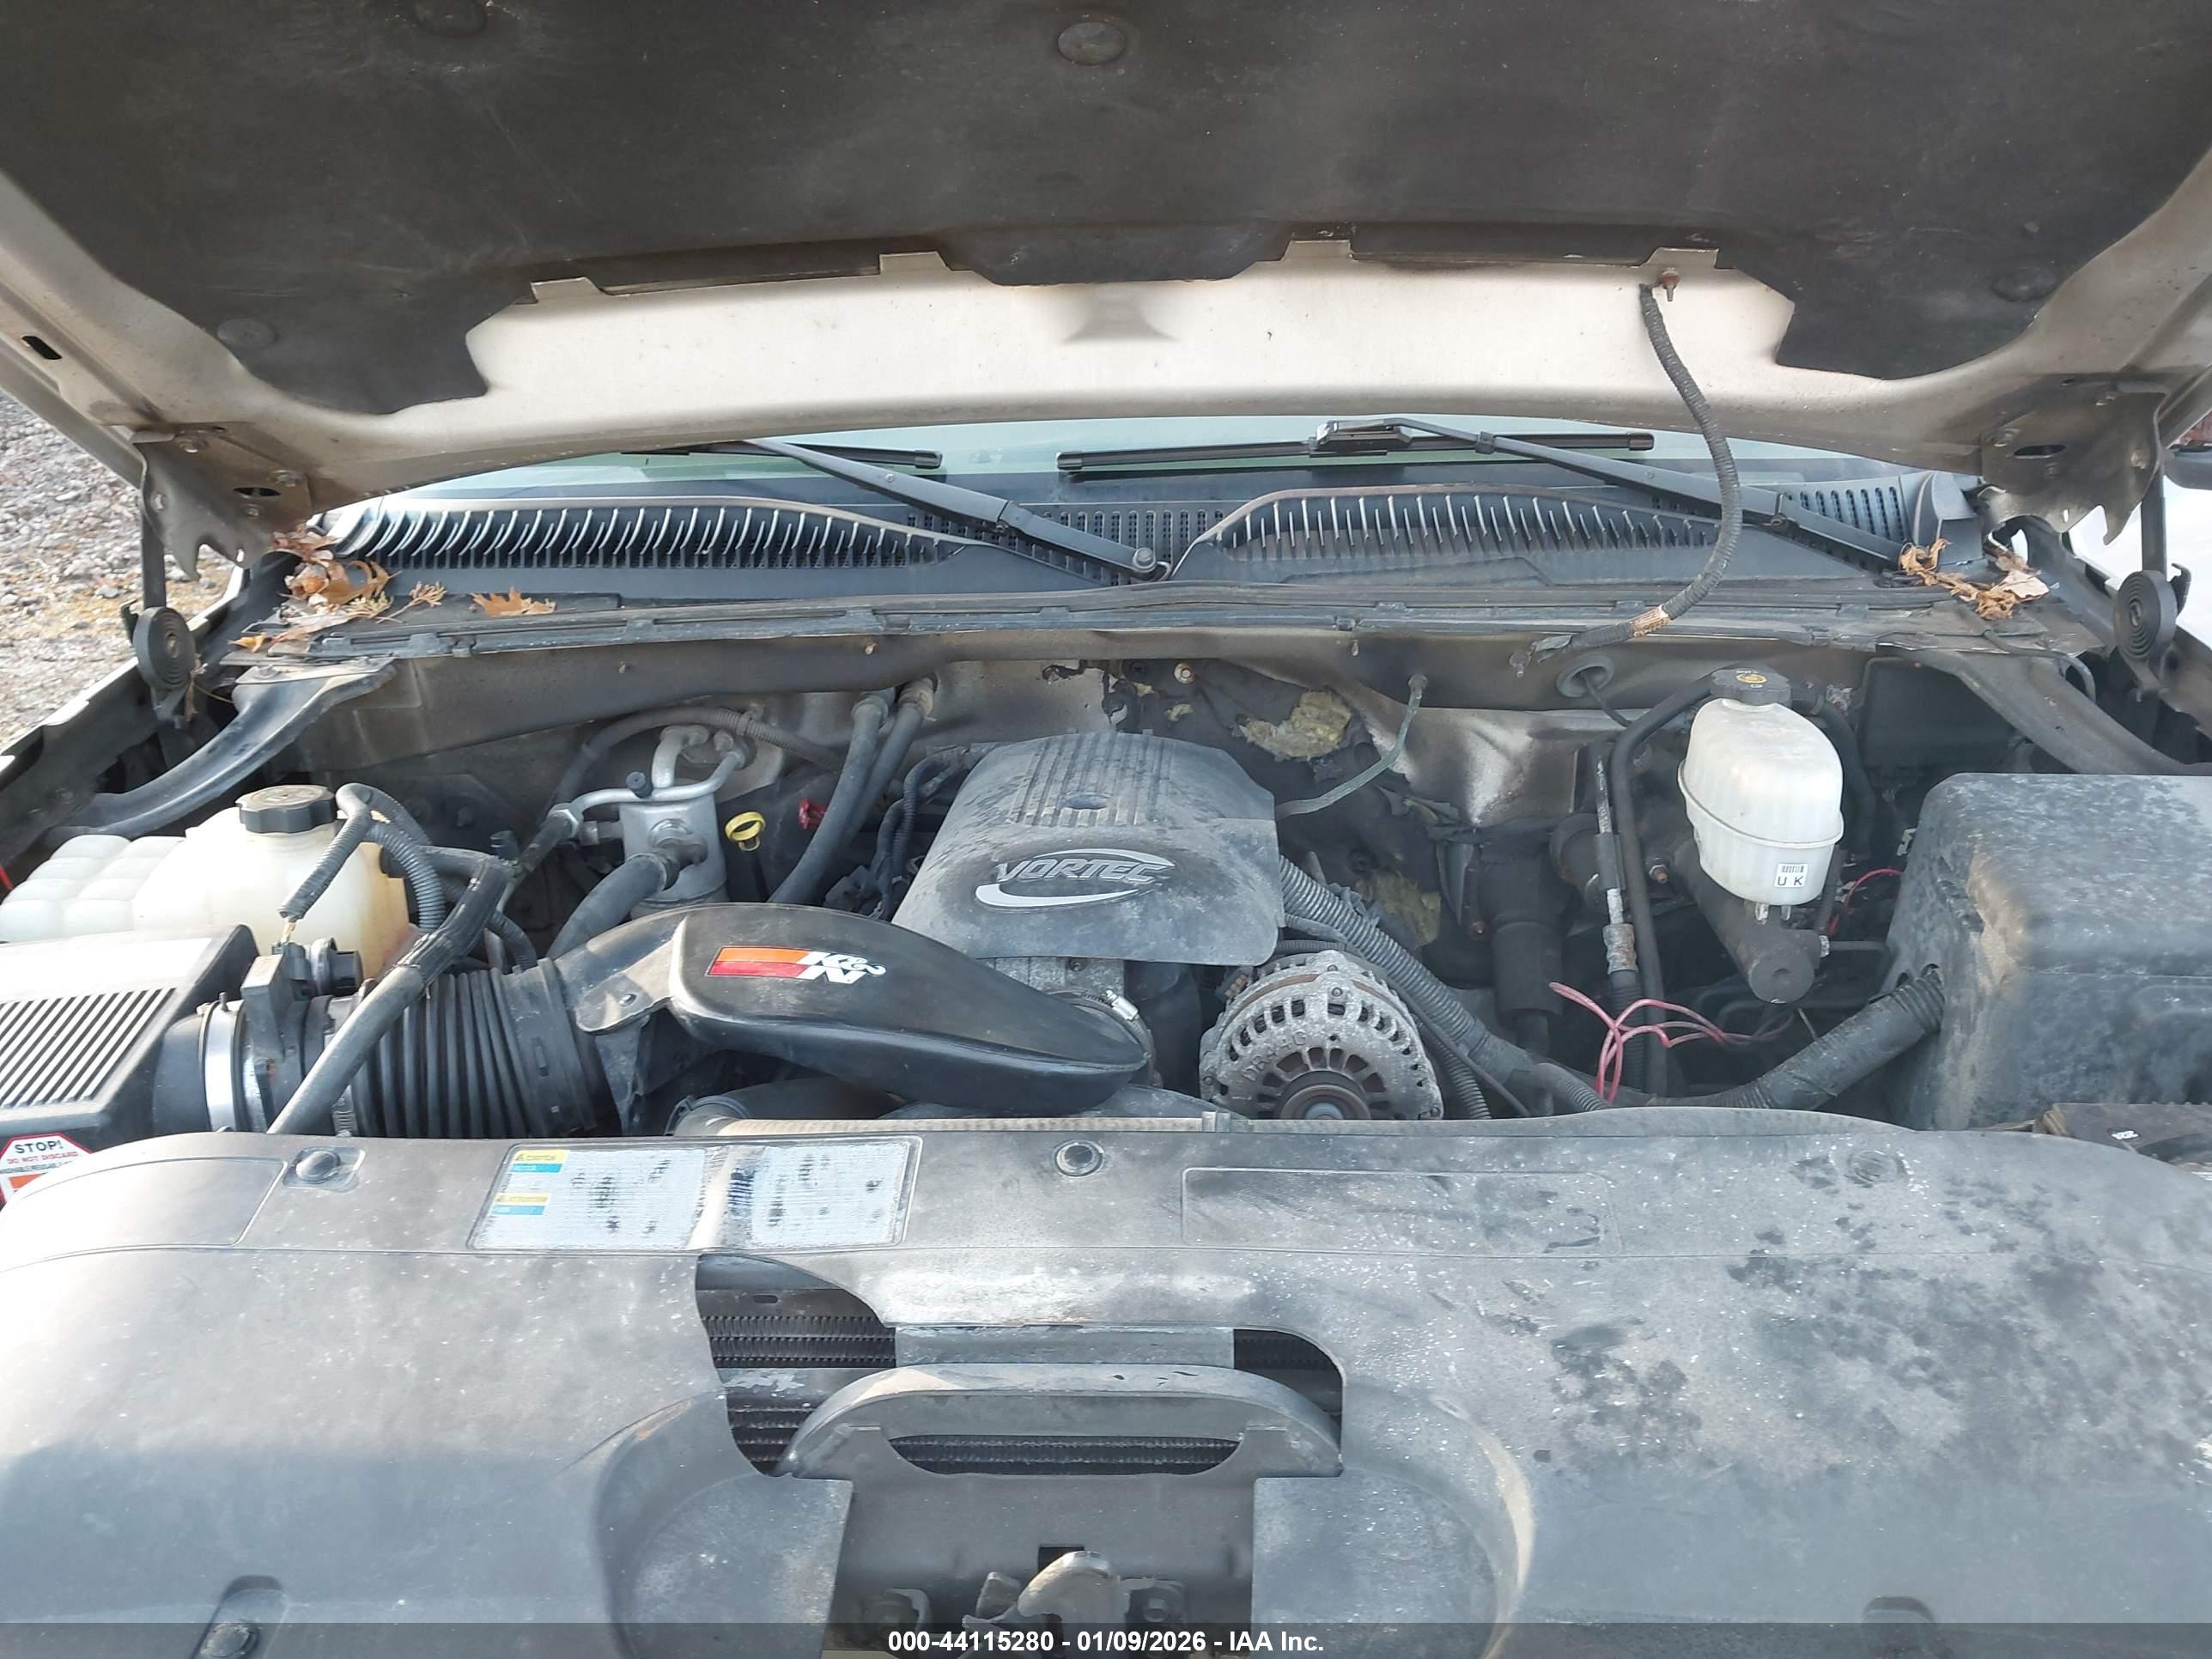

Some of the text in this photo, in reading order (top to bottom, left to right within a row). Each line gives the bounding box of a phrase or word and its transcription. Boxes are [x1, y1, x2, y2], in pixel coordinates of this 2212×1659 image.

[994, 858, 1168, 884] VORTEC
[796, 951, 887, 985] K&N
[14, 1139, 64, 1154] STOP!
